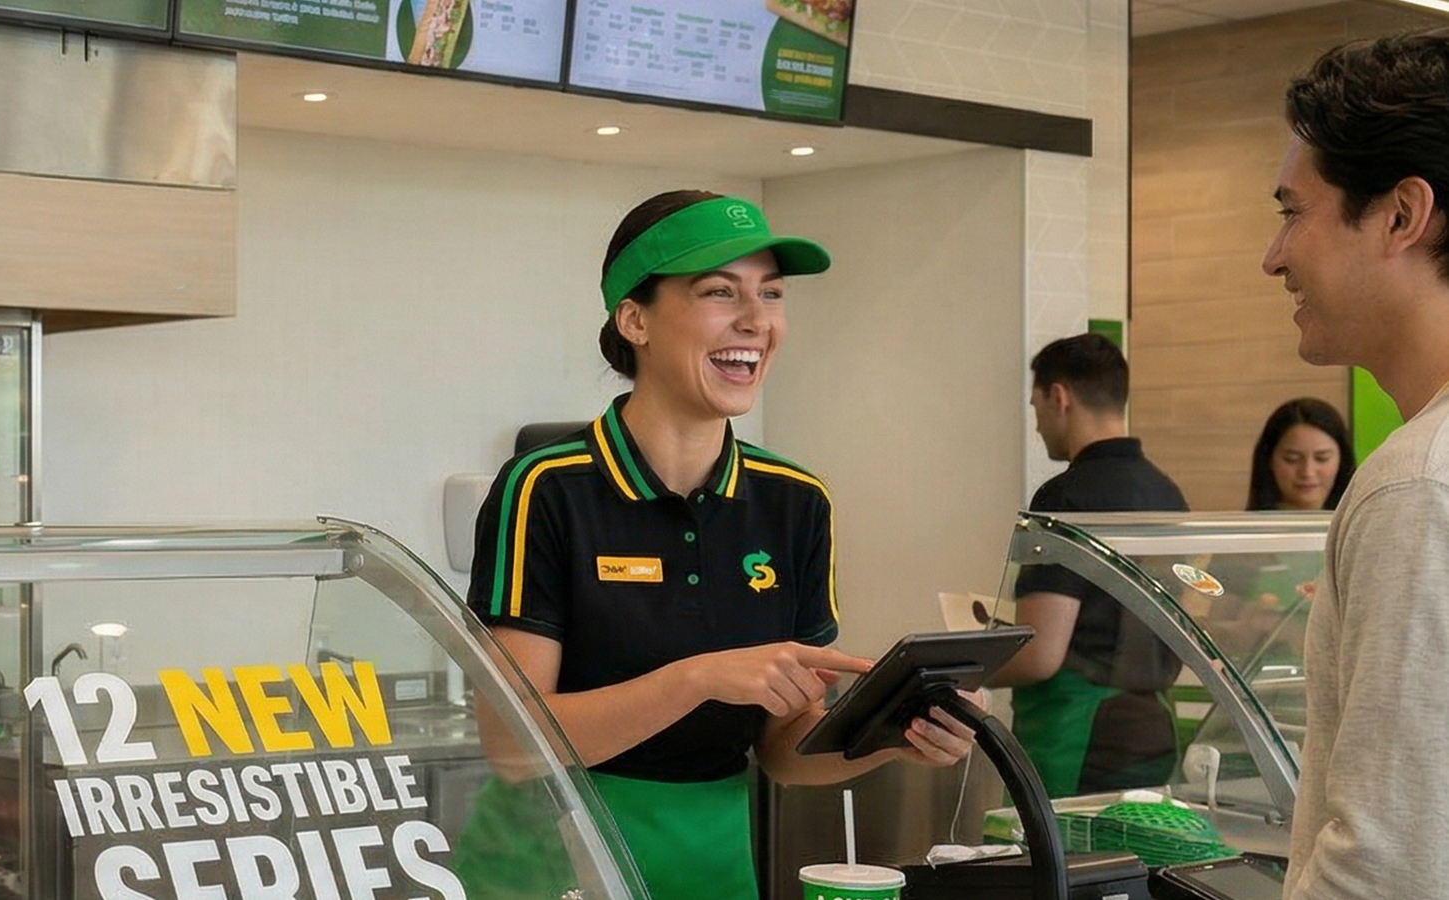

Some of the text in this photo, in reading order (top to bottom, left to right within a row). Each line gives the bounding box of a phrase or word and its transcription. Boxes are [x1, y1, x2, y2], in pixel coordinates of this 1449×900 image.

[23, 661, 394, 766] 12 NEW
[53, 754, 429, 838] IRRESISTIBLE
[93, 820, 468, 900] SERIES
